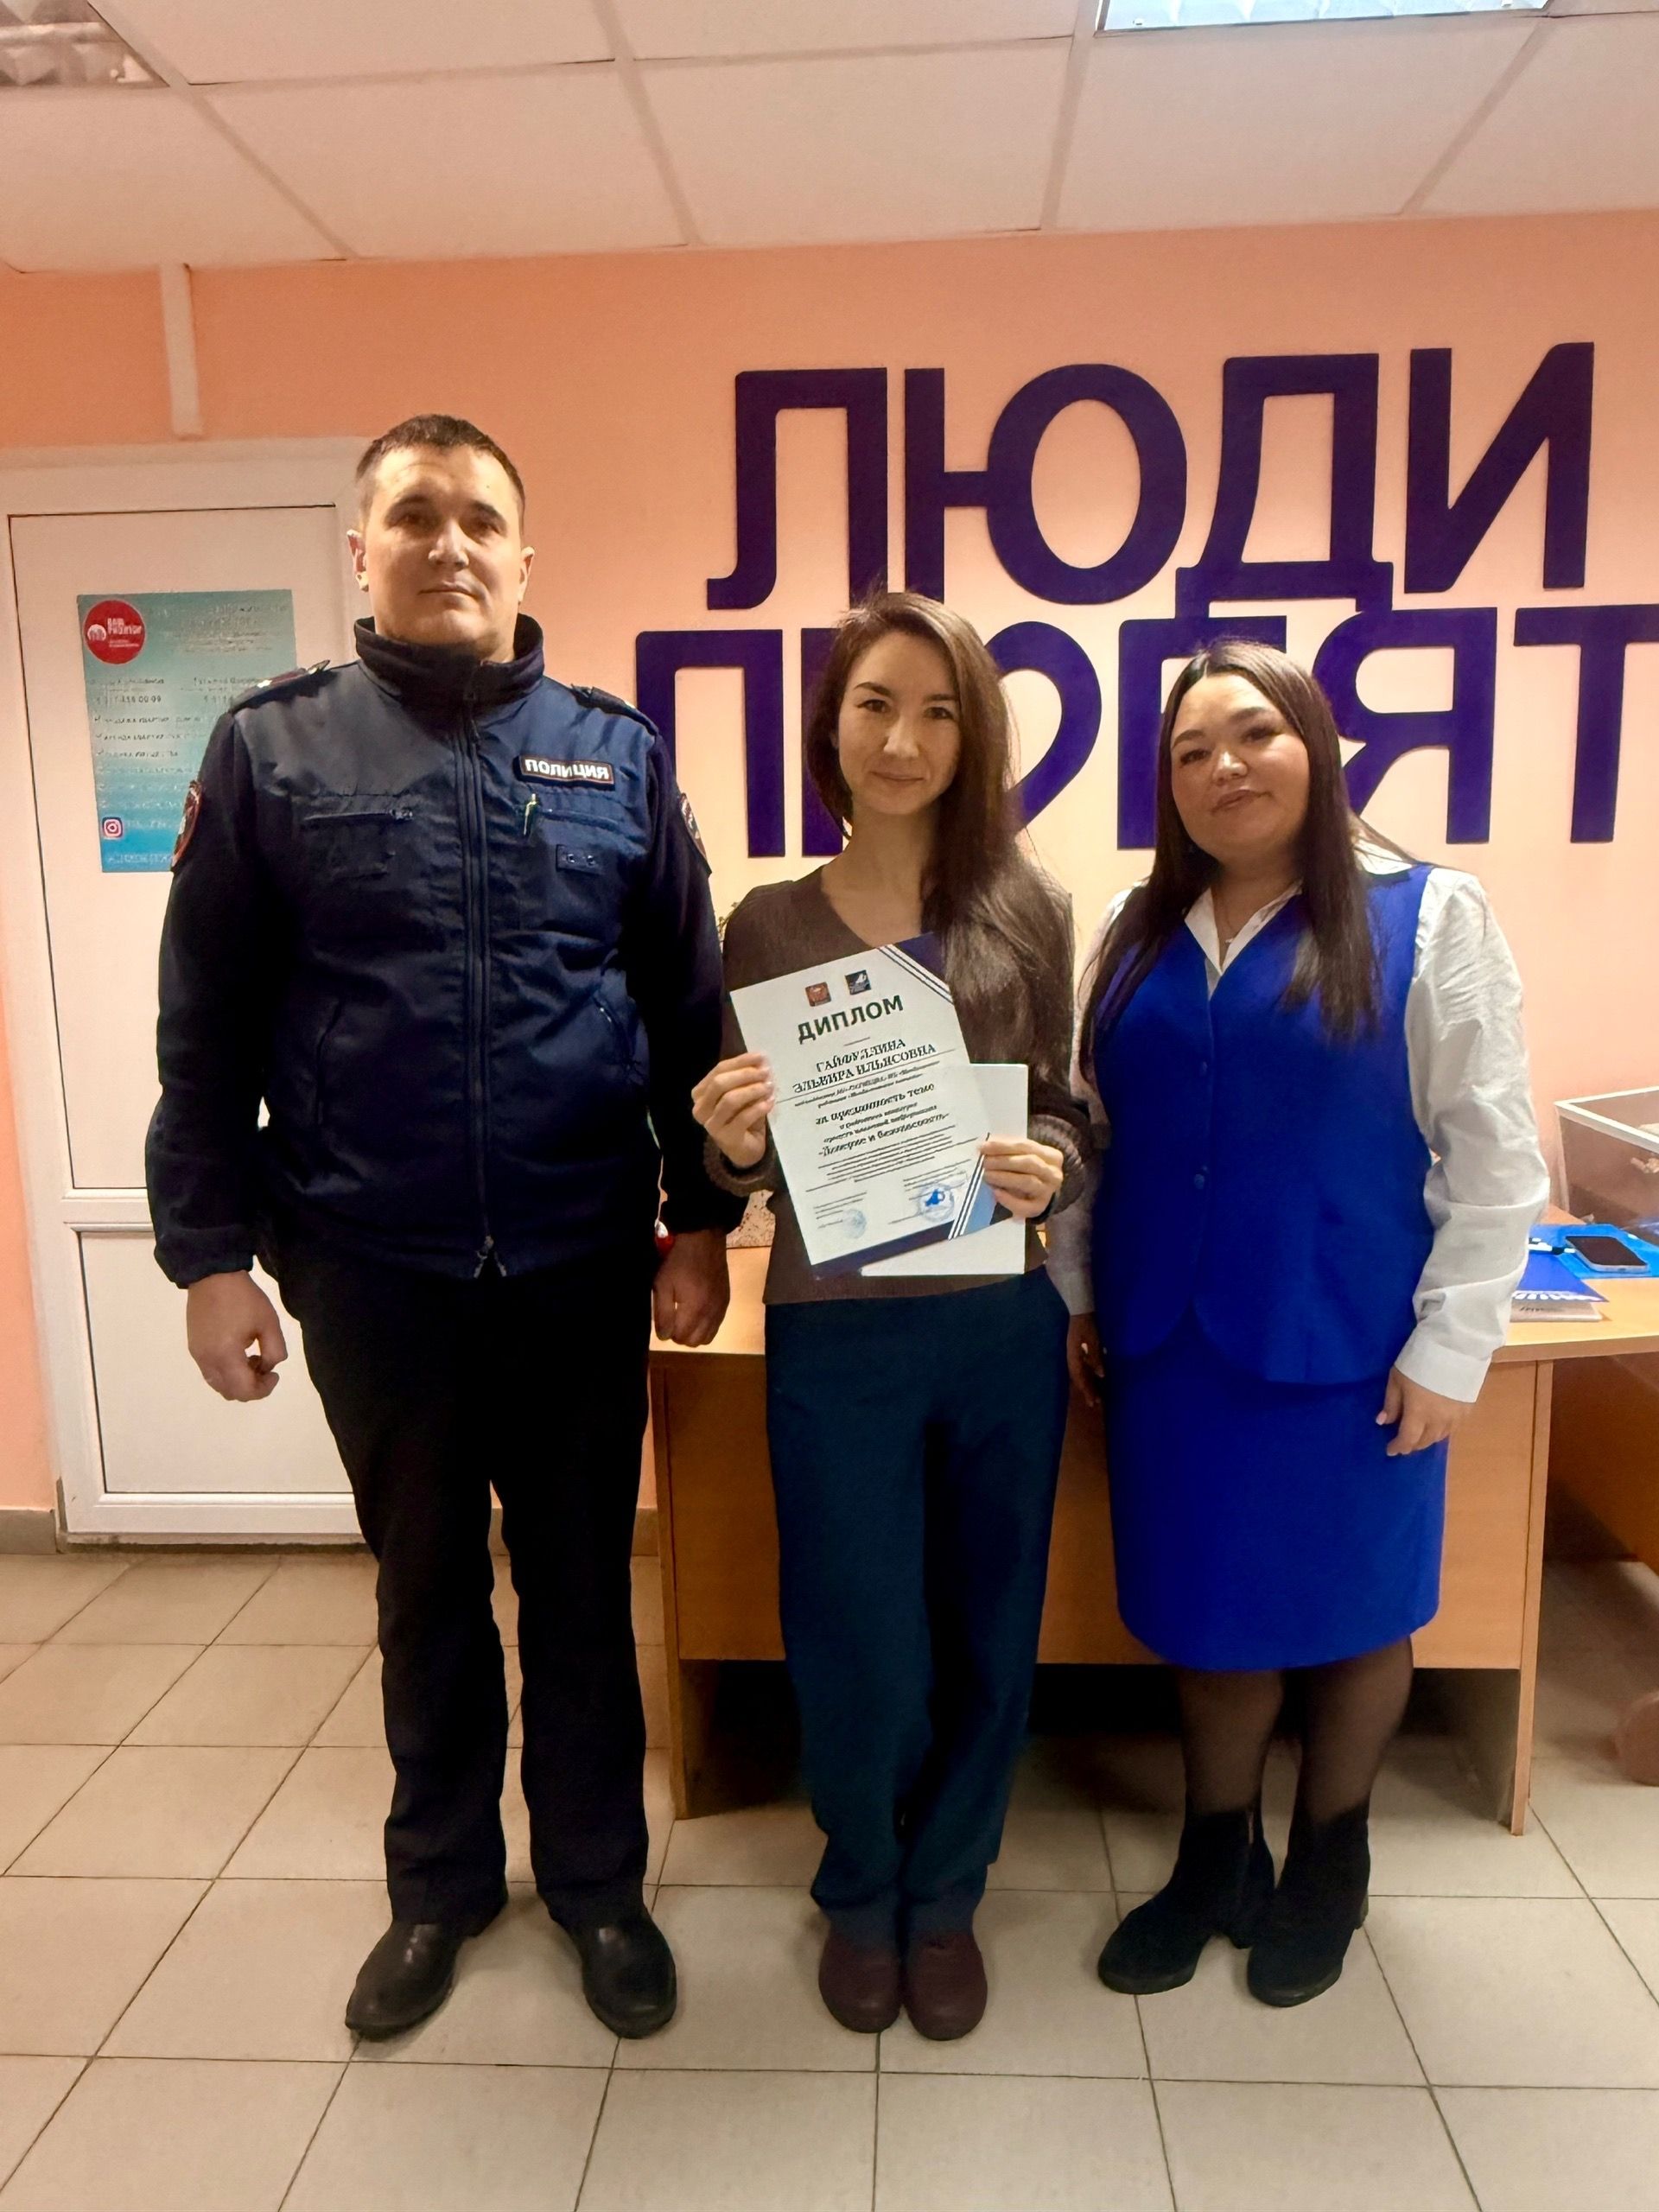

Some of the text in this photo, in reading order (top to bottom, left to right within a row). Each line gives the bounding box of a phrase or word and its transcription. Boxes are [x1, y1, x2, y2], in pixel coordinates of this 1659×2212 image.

[707, 341, 1595, 613] ЛЮДИ
[524, 759, 610, 780] ПОЛИЦИЯ
[798, 995, 903, 1044] ДИПЛОМ
